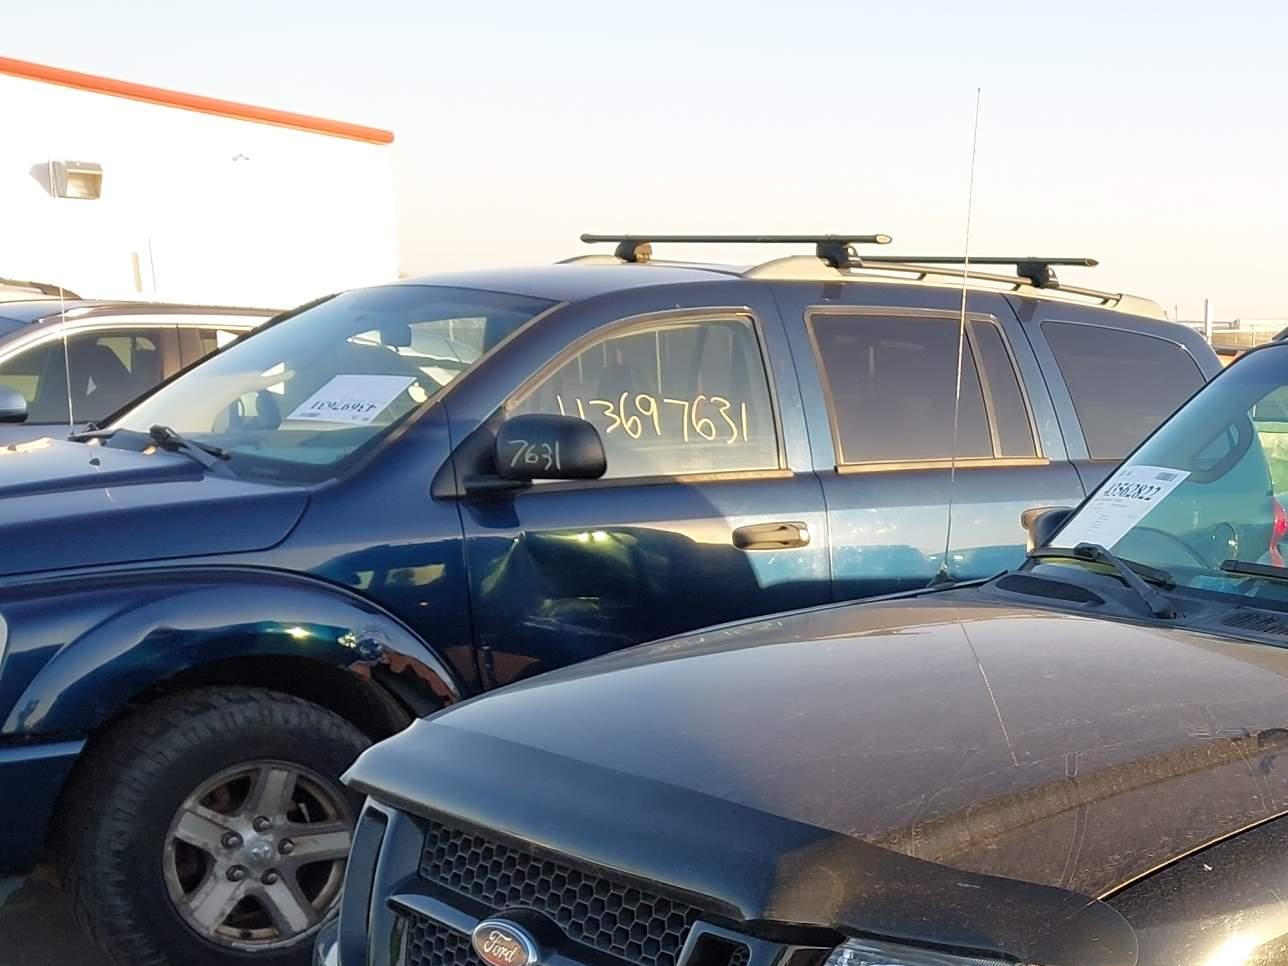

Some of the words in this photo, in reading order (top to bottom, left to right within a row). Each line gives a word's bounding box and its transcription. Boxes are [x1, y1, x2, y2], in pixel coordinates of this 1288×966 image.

[508, 439, 562, 471] 7631
[1103, 482, 1162, 501] 43562822
[483, 930, 519, 964] Ford
